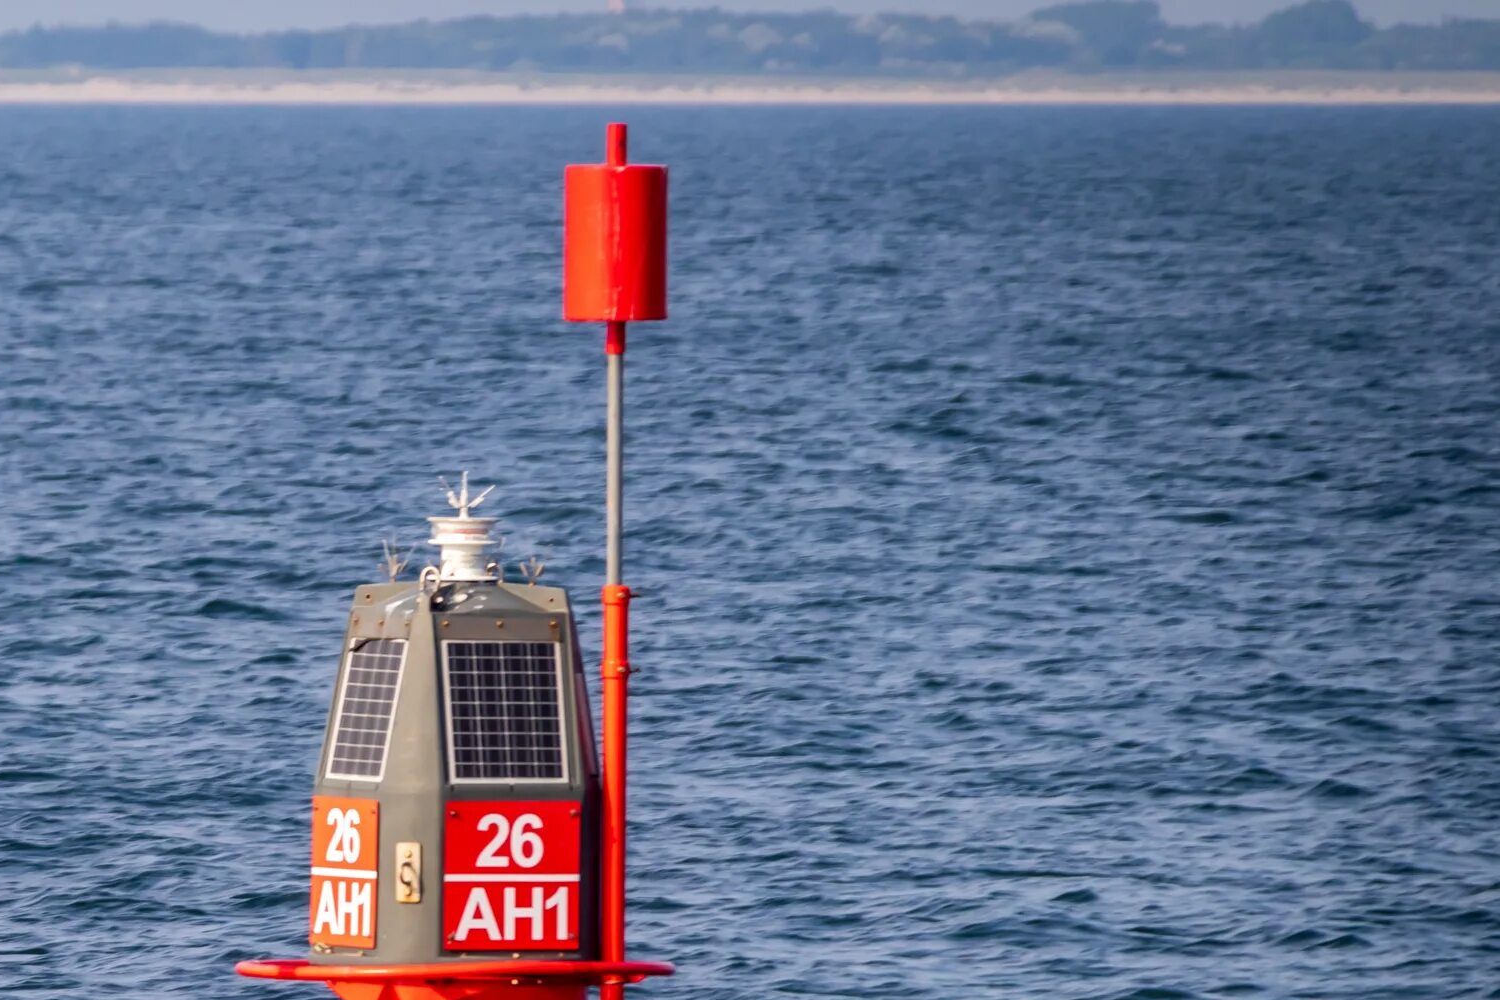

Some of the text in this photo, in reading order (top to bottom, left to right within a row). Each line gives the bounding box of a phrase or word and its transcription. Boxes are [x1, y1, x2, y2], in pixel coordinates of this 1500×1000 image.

[325, 808, 361, 864] 26
[475, 813, 544, 868] 26
[313, 880, 372, 937] AH1
[453, 886, 569, 941] AH1
